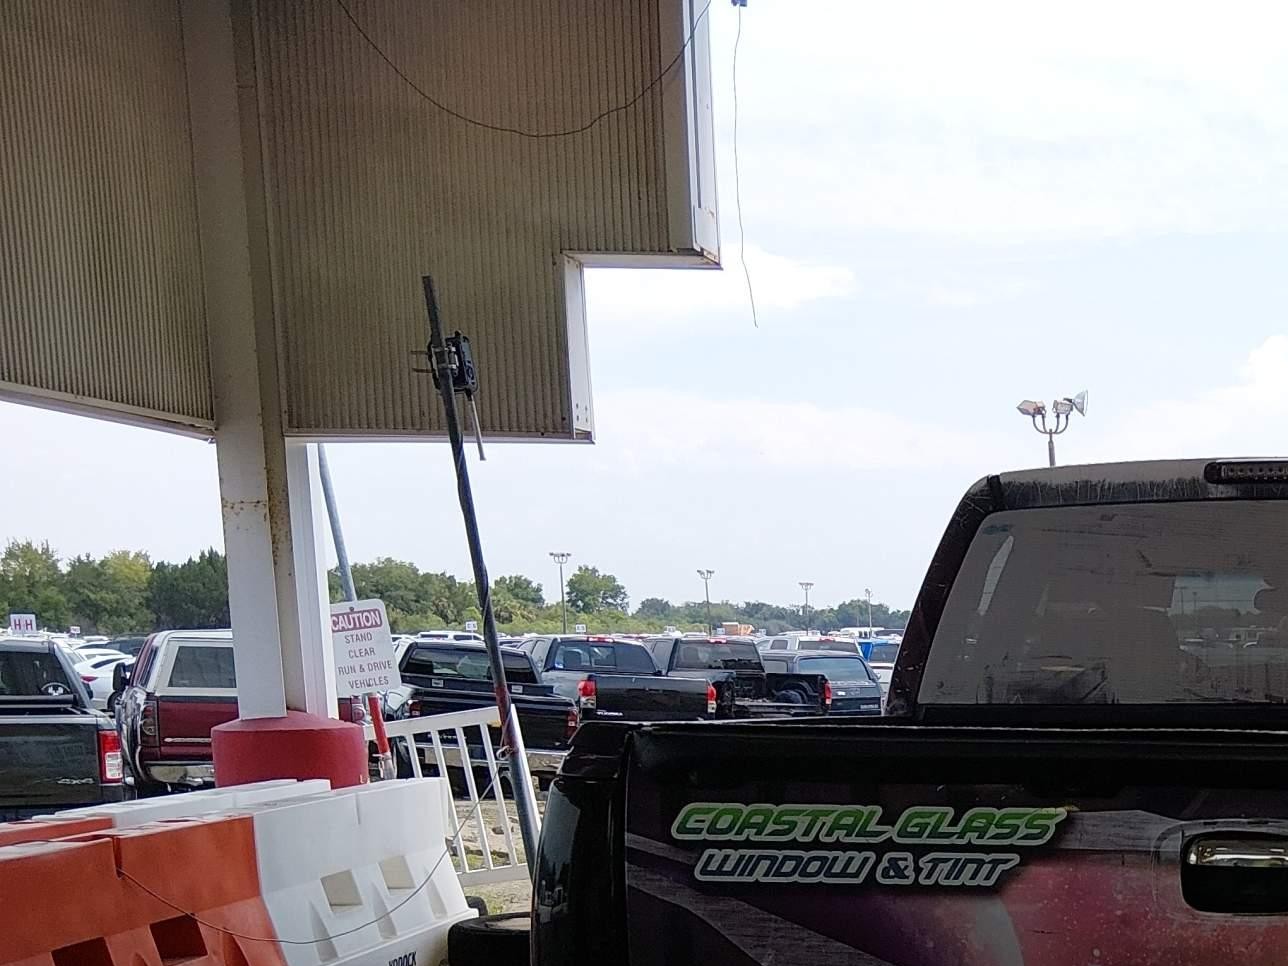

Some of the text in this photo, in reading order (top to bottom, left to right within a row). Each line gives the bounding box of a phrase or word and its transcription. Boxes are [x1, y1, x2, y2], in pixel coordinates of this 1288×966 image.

[331, 611, 381, 631] CAUTION
[344, 631, 373, 644] STAND
[348, 647, 376, 659] CLEAR
[338, 660, 393, 676] RUN & DRIVE
[348, 676, 389, 689] VEHICLES
[673, 803, 1064, 844] COASTAL GLASS
[696, 849, 1018, 886] WINDOW & TINT
